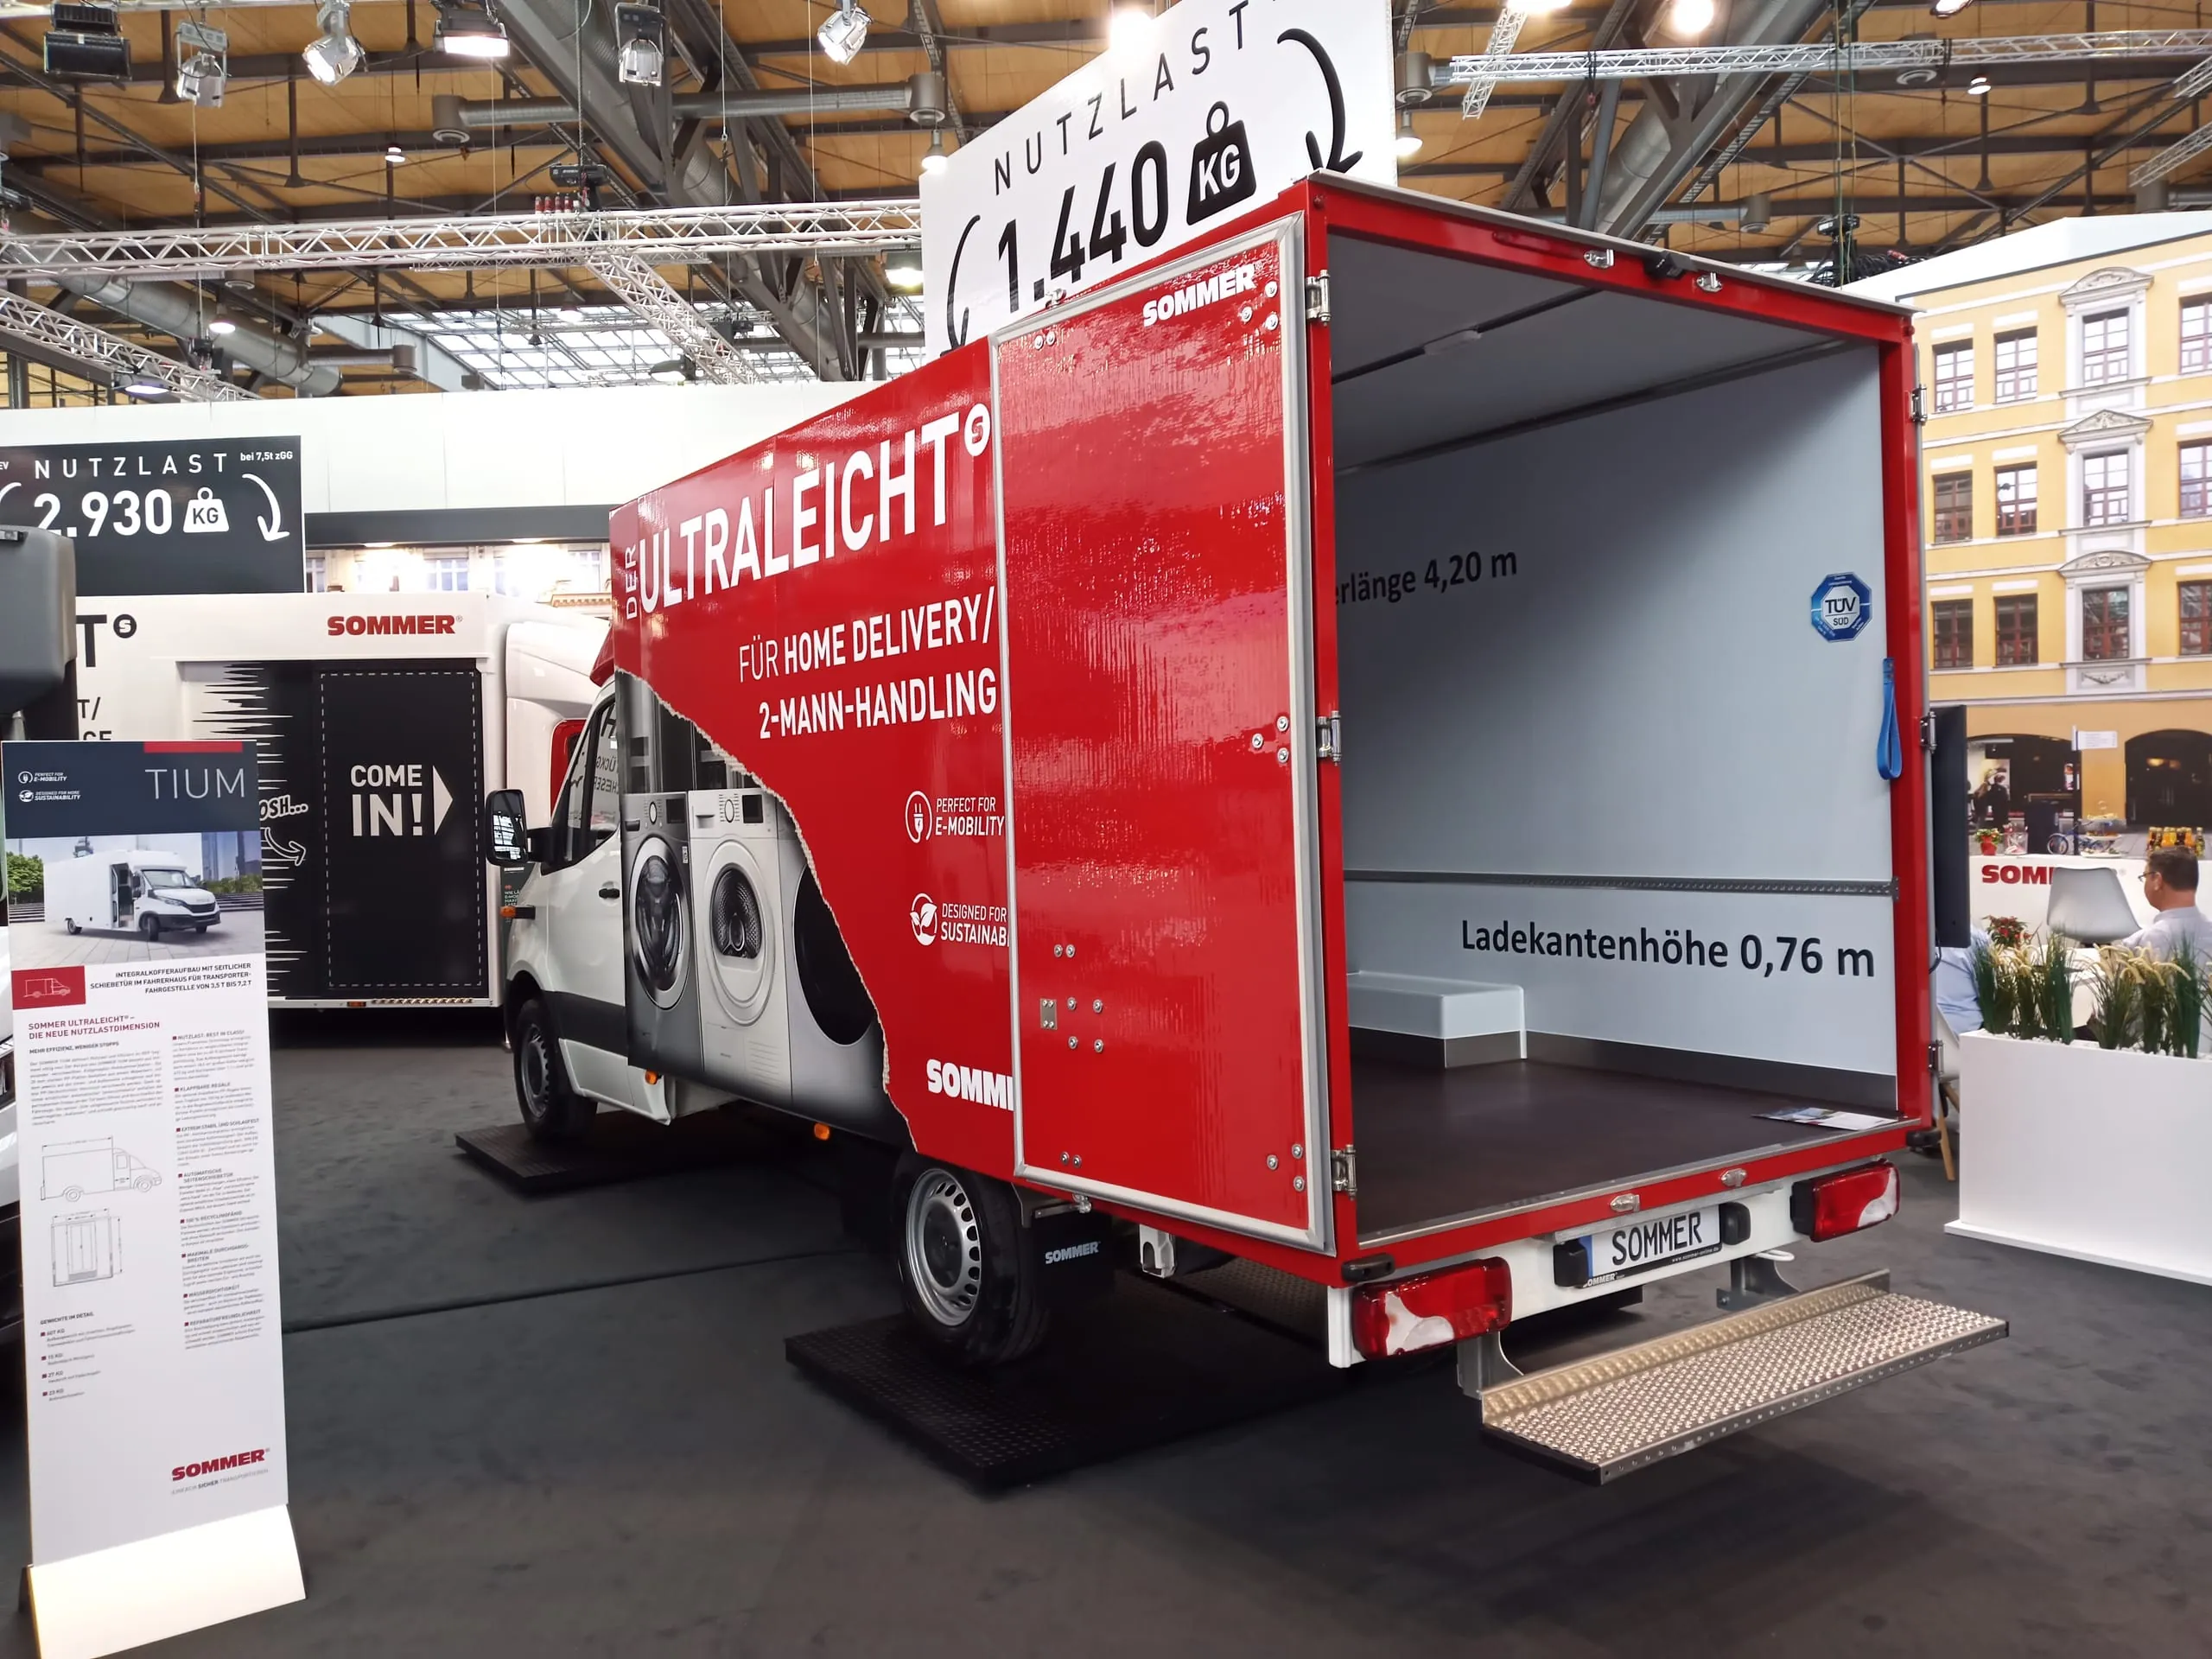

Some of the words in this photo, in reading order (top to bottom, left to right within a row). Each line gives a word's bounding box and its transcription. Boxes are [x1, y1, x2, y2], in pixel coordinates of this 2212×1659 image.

[995, 0, 1249, 196] NUTZLAST
[998, 140, 1169, 314] 1.440
[1198, 144, 1241, 202] KG
[35, 453, 227, 480] NUTZLAST
[240, 452, 254, 461] bei
[256, 451, 273, 461] 7,5t
[275, 451, 293, 460] zGG
[34, 489, 172, 537] 2.930
[193, 508, 219, 524] KG
[639, 411, 960, 613] ULTRALEICHT
[625, 544, 638, 620] DER
[1335, 569, 1416, 605] rlänge
[1424, 551, 1481, 594] 4,20
[1491, 552, 1516, 578] m
[1825, 596, 1857, 613] TÜV
[1833, 617, 1849, 626] SÜD
[739, 634, 779, 683] FÜR
[784, 624, 846, 675] HOME
[853, 586, 995, 663] DELIVERY/
[759, 667, 997, 740] 2-MANN-HANDLING
[144, 768, 245, 799] TIUM
[350, 765, 423, 786] COME
[352, 794, 423, 836] IN!
[937, 798, 976, 812] PERFECT
[977, 797, 996, 812] FOR
[935, 816, 1005, 836] E-MOBILITY
[1981, 864, 2054, 885] SOM
[942, 903, 987, 921] DESIGNED
[988, 906, 1007, 923] FOR
[1462, 919, 1728, 968] Ladekantenhöhe
[1741, 934, 1824, 978] 0,76
[1837, 946, 1875, 977] m
[116, 967, 200, 978] INTEGRALKOFFERAUFBAU
[214, 963, 251, 971] SEITLICHER
[90, 980, 133, 989] SCHIEBETÜR
[143, 976, 188, 985] FAHRERHAUS
[145, 984, 195, 995] FAHRGESTELLE
[29, 1020, 66, 1030] SOMMER
[45, 1029, 69, 1039] NEUE
[71, 1021, 160, 1036] NUTZLASTDIMENSION
[1612, 1211, 1702, 1266] SOMMER
[198, 1480, 219, 1489] SICHER
